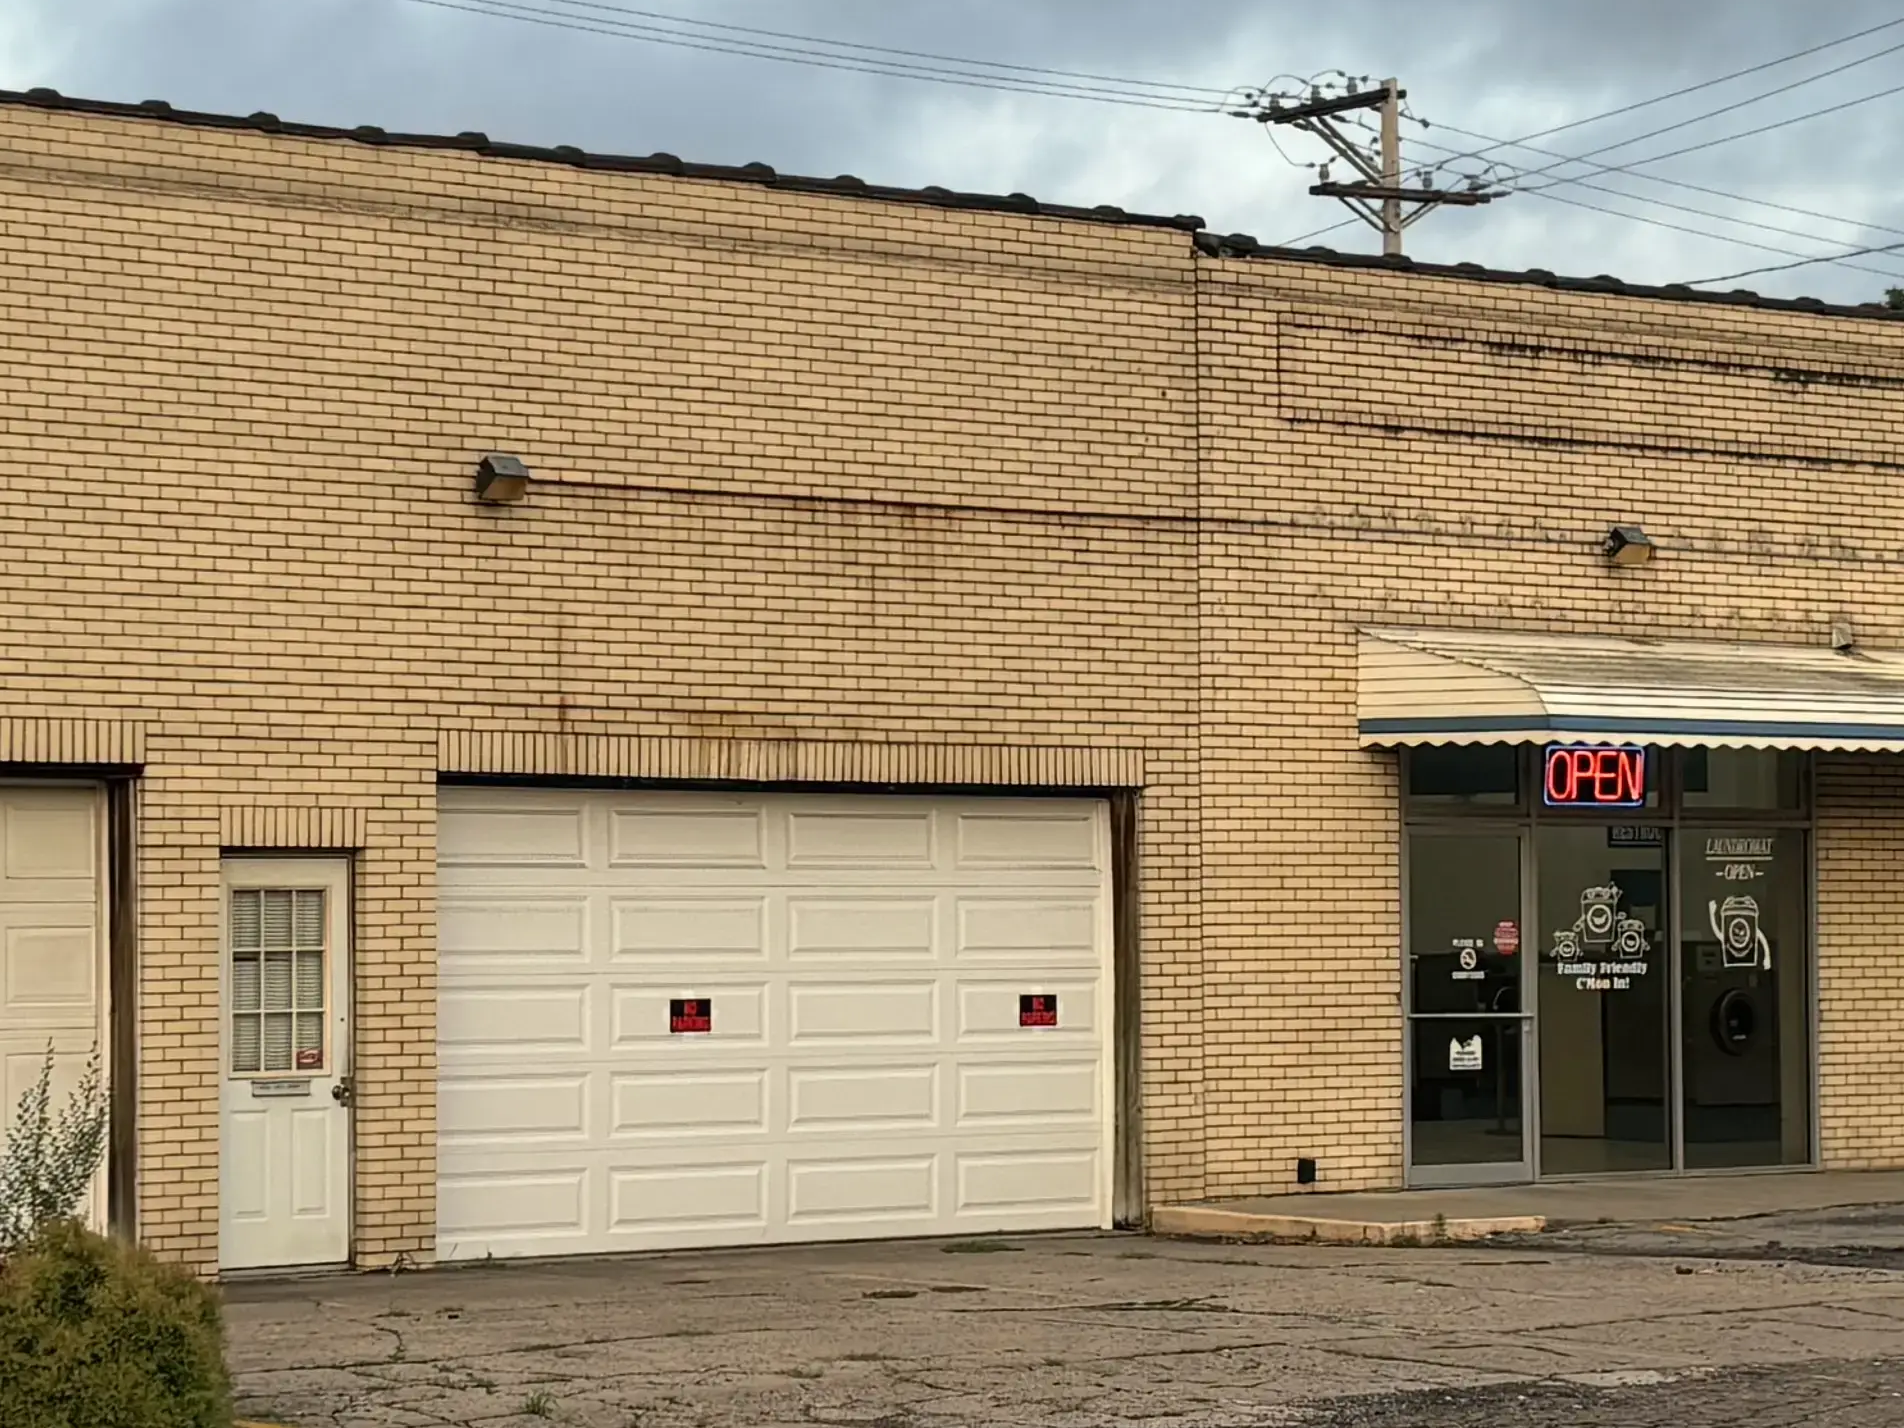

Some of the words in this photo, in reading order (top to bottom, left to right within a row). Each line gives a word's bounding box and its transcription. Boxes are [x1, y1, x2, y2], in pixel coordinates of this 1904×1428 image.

[1547, 750, 1643, 801] OPEN
[1557, 962, 1597, 975] Family
[1599, 961, 1648, 975] Friendly
